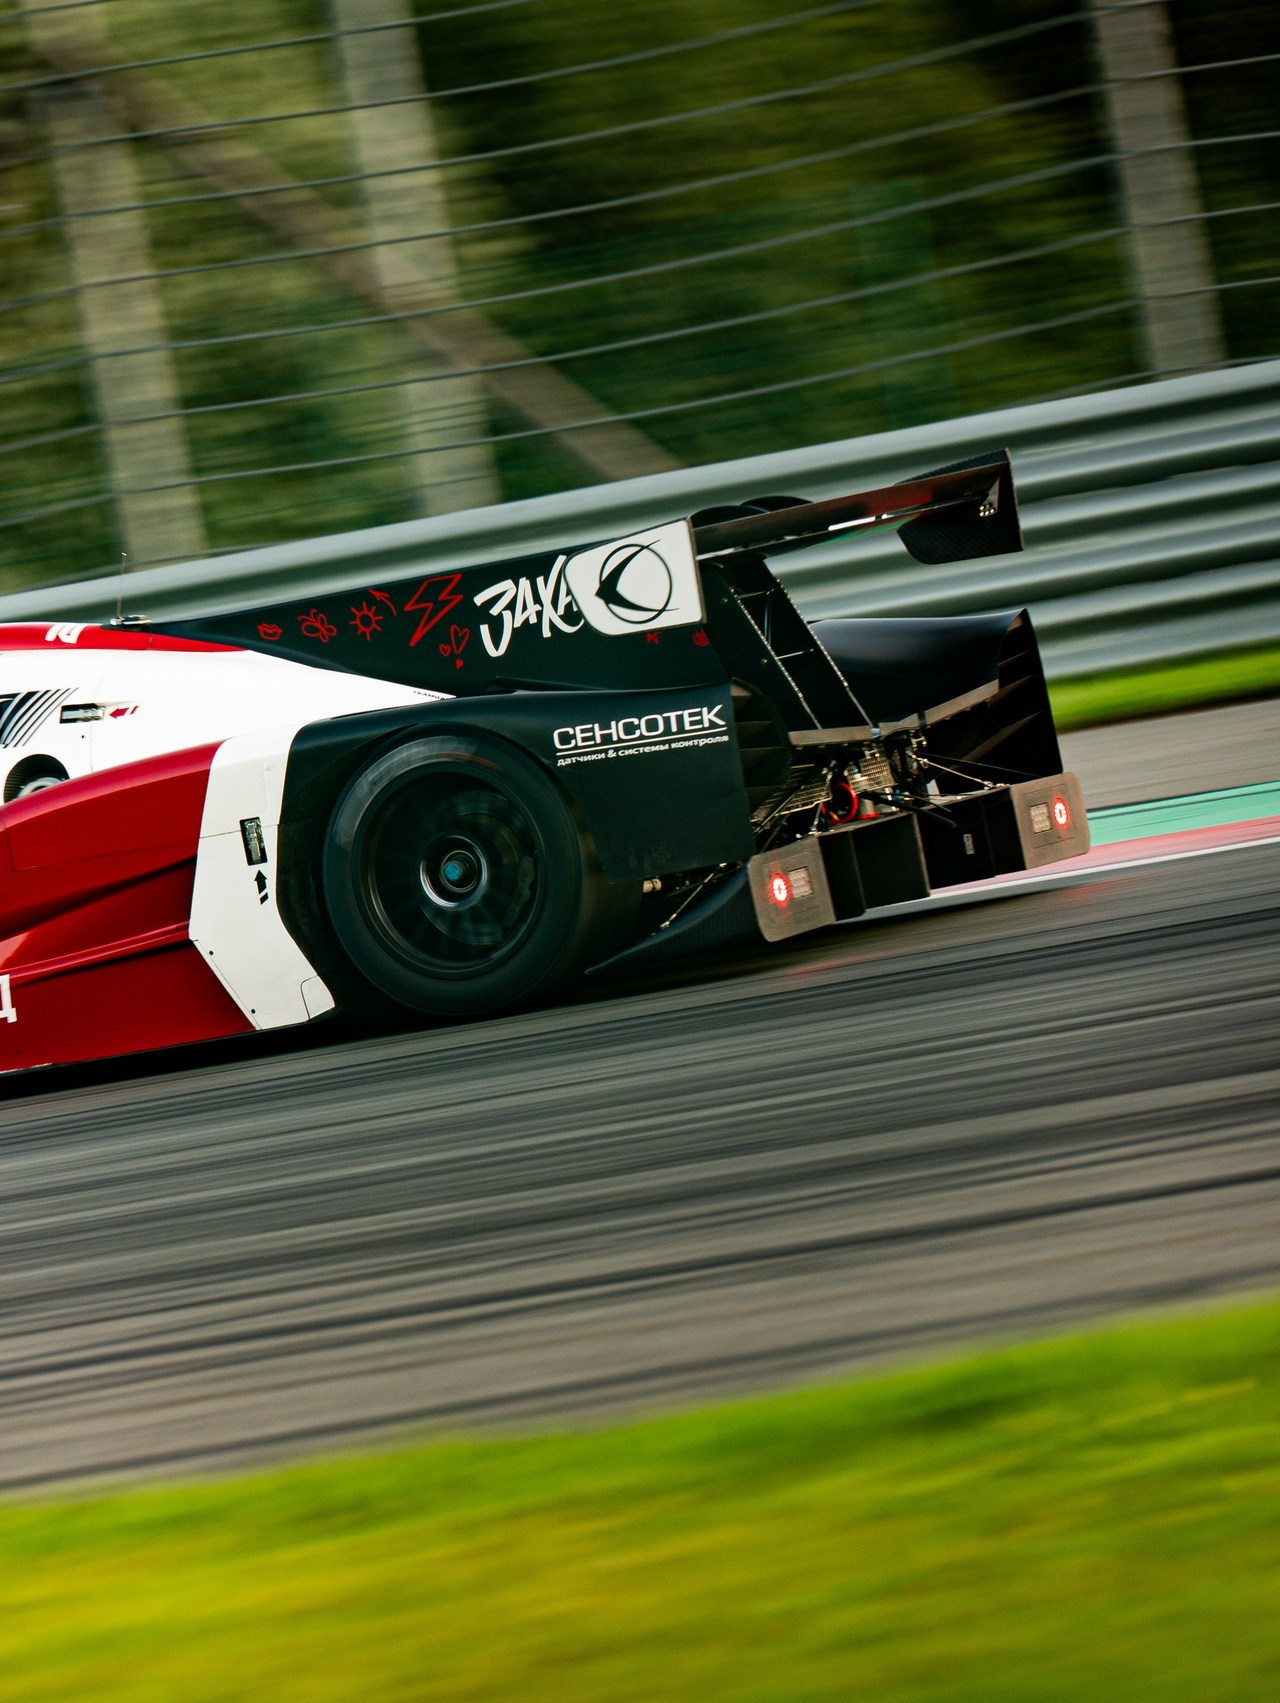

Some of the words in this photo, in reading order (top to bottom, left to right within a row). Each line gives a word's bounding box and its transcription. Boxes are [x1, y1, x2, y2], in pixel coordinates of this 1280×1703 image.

[552, 704, 726, 749] СЕНСОТЕК
[557, 753, 606, 767] датчики
[607, 749, 617, 758] &
[618, 743, 669, 757] системы
[671, 735, 729, 749] контроля
